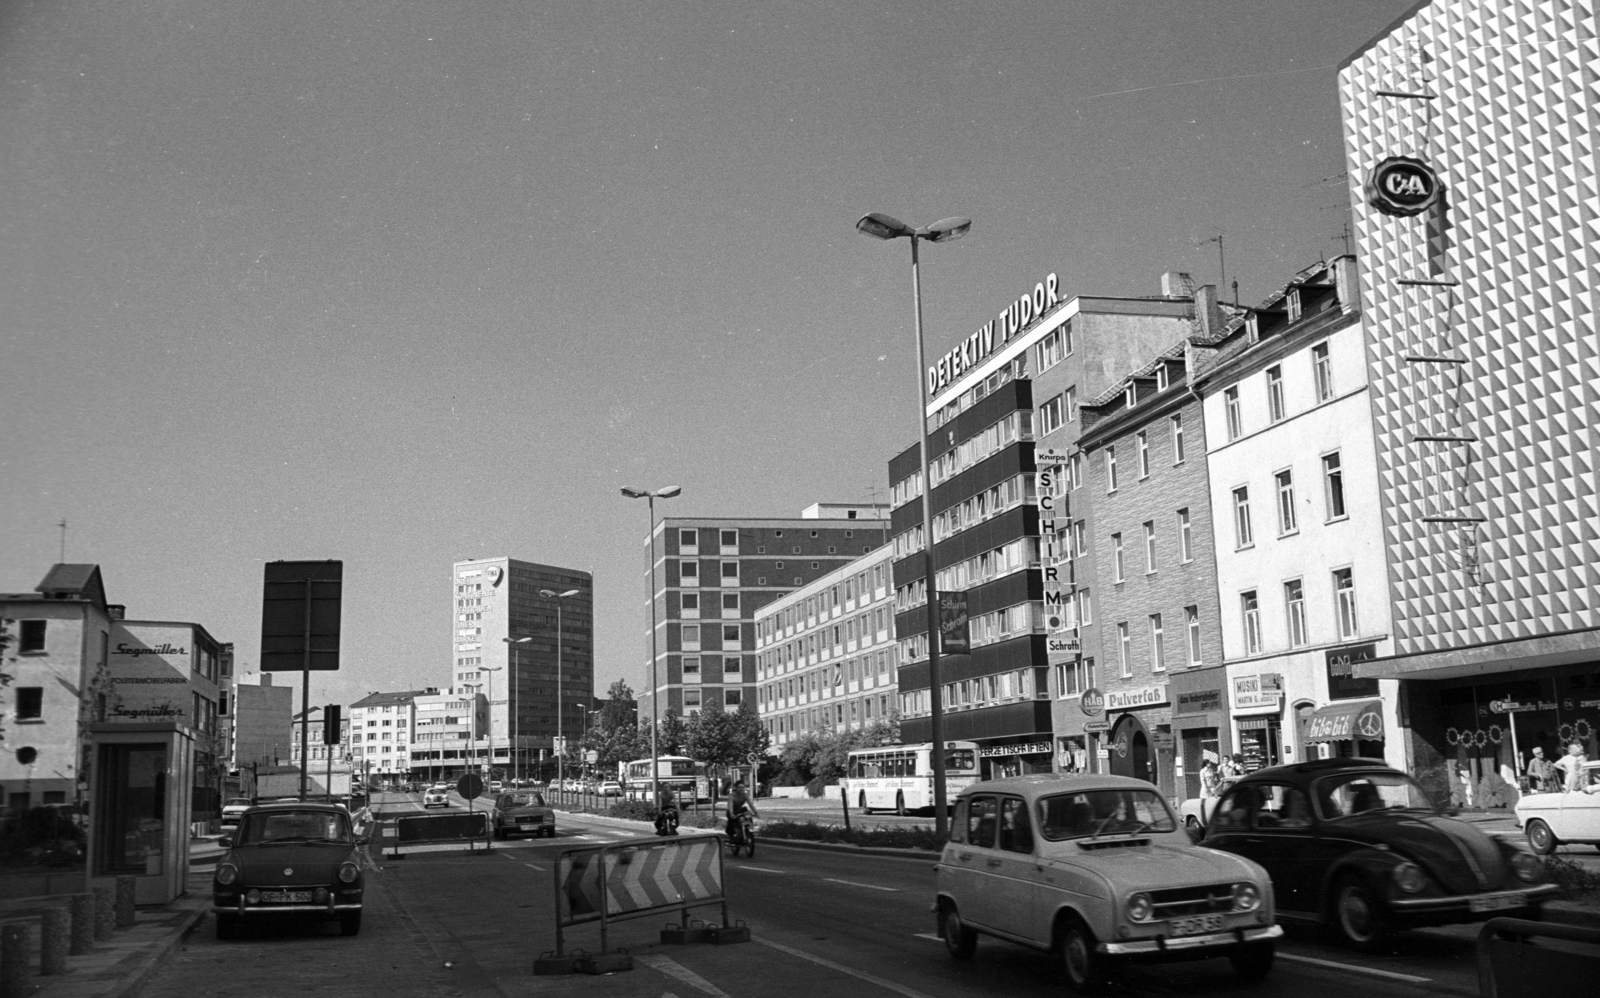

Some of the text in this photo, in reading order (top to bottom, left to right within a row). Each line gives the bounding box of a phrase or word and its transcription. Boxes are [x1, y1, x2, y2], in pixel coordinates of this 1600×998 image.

[1386, 173, 1428, 196] C&A
[928, 273, 1059, 395] DETEKTIV TUDOR
[1038, 450, 1066, 463] Knirps
[941, 600, 967, 609] Schirm
[111, 643, 189, 657] Segmüller
[1049, 640, 1080, 651] Schroth
[1108, 688, 1161, 707] Pulverfaß
[108, 704, 186, 719] Segmüller
